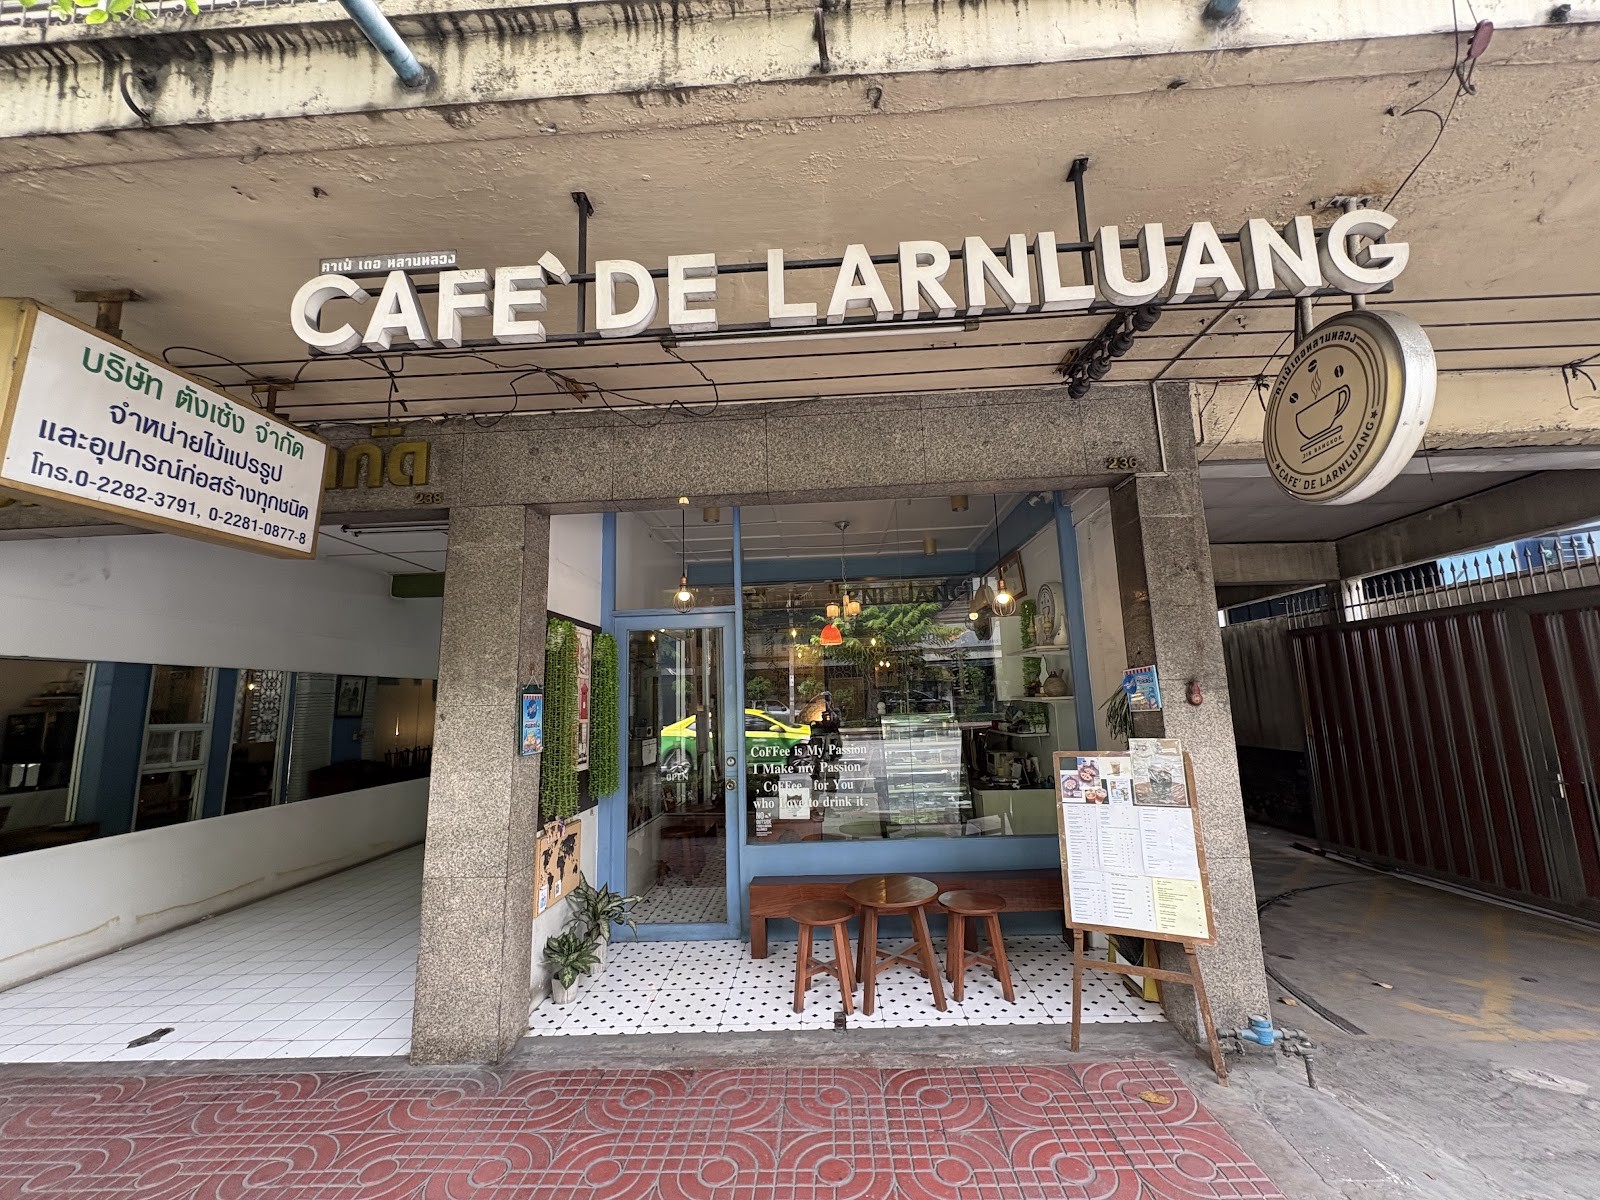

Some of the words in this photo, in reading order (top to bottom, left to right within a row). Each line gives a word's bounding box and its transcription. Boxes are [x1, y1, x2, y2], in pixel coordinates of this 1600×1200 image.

[387, 254, 456, 268] หลานหลวง
[595, 253, 718, 338] DE
[767, 209, 1410, 327] LARNLUANG
[82, 347, 163, 401] บริษัท
[255, 421, 304, 460] จำกัด
[109, 401, 283, 485] จำหน่ายไม้แปรรูป
[1314, 435, 1343, 452] BANGKOK
[1108, 457, 1138, 469] 236
[1303, 479, 1316, 490] DE
[1320, 421, 1374, 487] LARNLUANG
[39, 419, 309, 520] และอุปกรณ์ก่อสร้างทุกชนิด
[208, 507, 306, 545] 0-2281-0877-8
[794, 746, 802, 756] is
[807, 745, 824, 758] My
[828, 744, 867, 756] Passion
[753, 764, 759, 774] I
[763, 763, 794, 774] Make
[798, 764, 815, 775] my
[820, 762, 861, 773] Passion
[666, 772, 689, 781] OPEN
[814, 780, 829, 791] for
[833, 780, 854, 790] You
[753, 798, 774, 809] who
[779, 798, 804, 808] Love
[809, 798, 818, 808] to
[823, 796, 851, 807] drink
